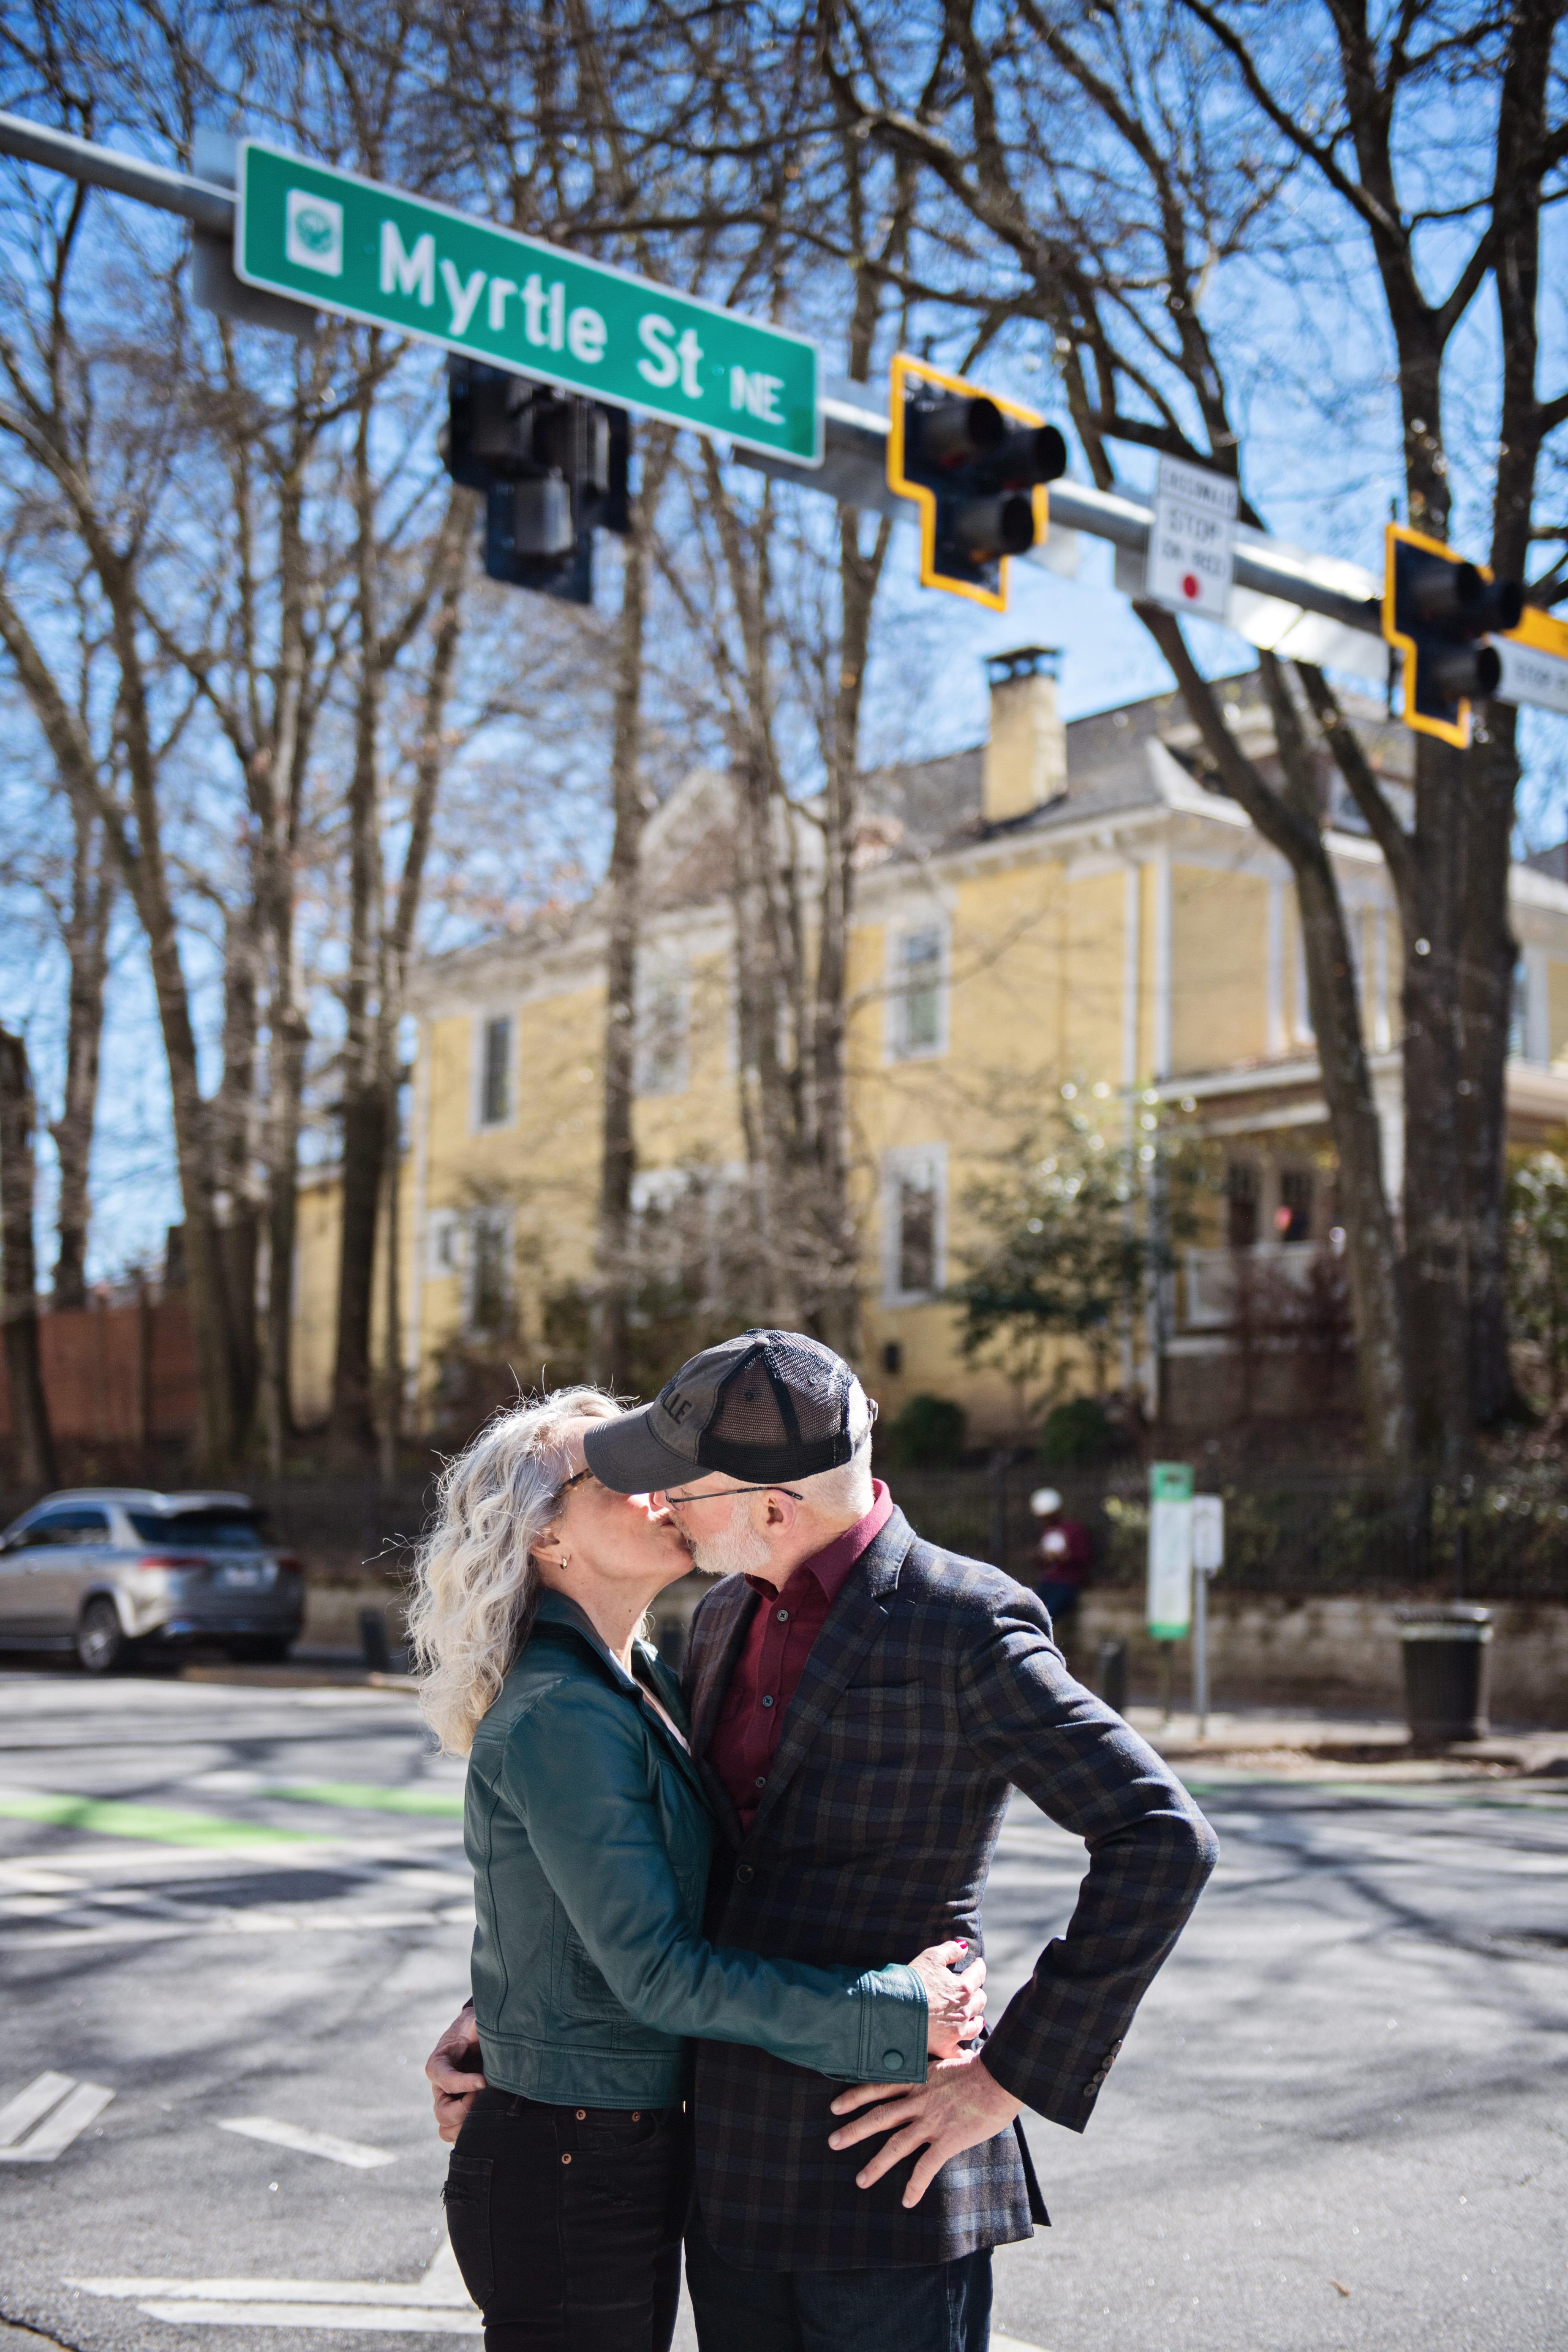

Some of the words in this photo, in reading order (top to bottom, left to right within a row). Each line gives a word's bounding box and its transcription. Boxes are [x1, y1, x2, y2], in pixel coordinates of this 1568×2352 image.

[380, 220, 607, 364] Myrtle
[637, 313, 704, 399] St
[730, 365, 784, 424] NE
[1168, 506, 1222, 542] STOP
